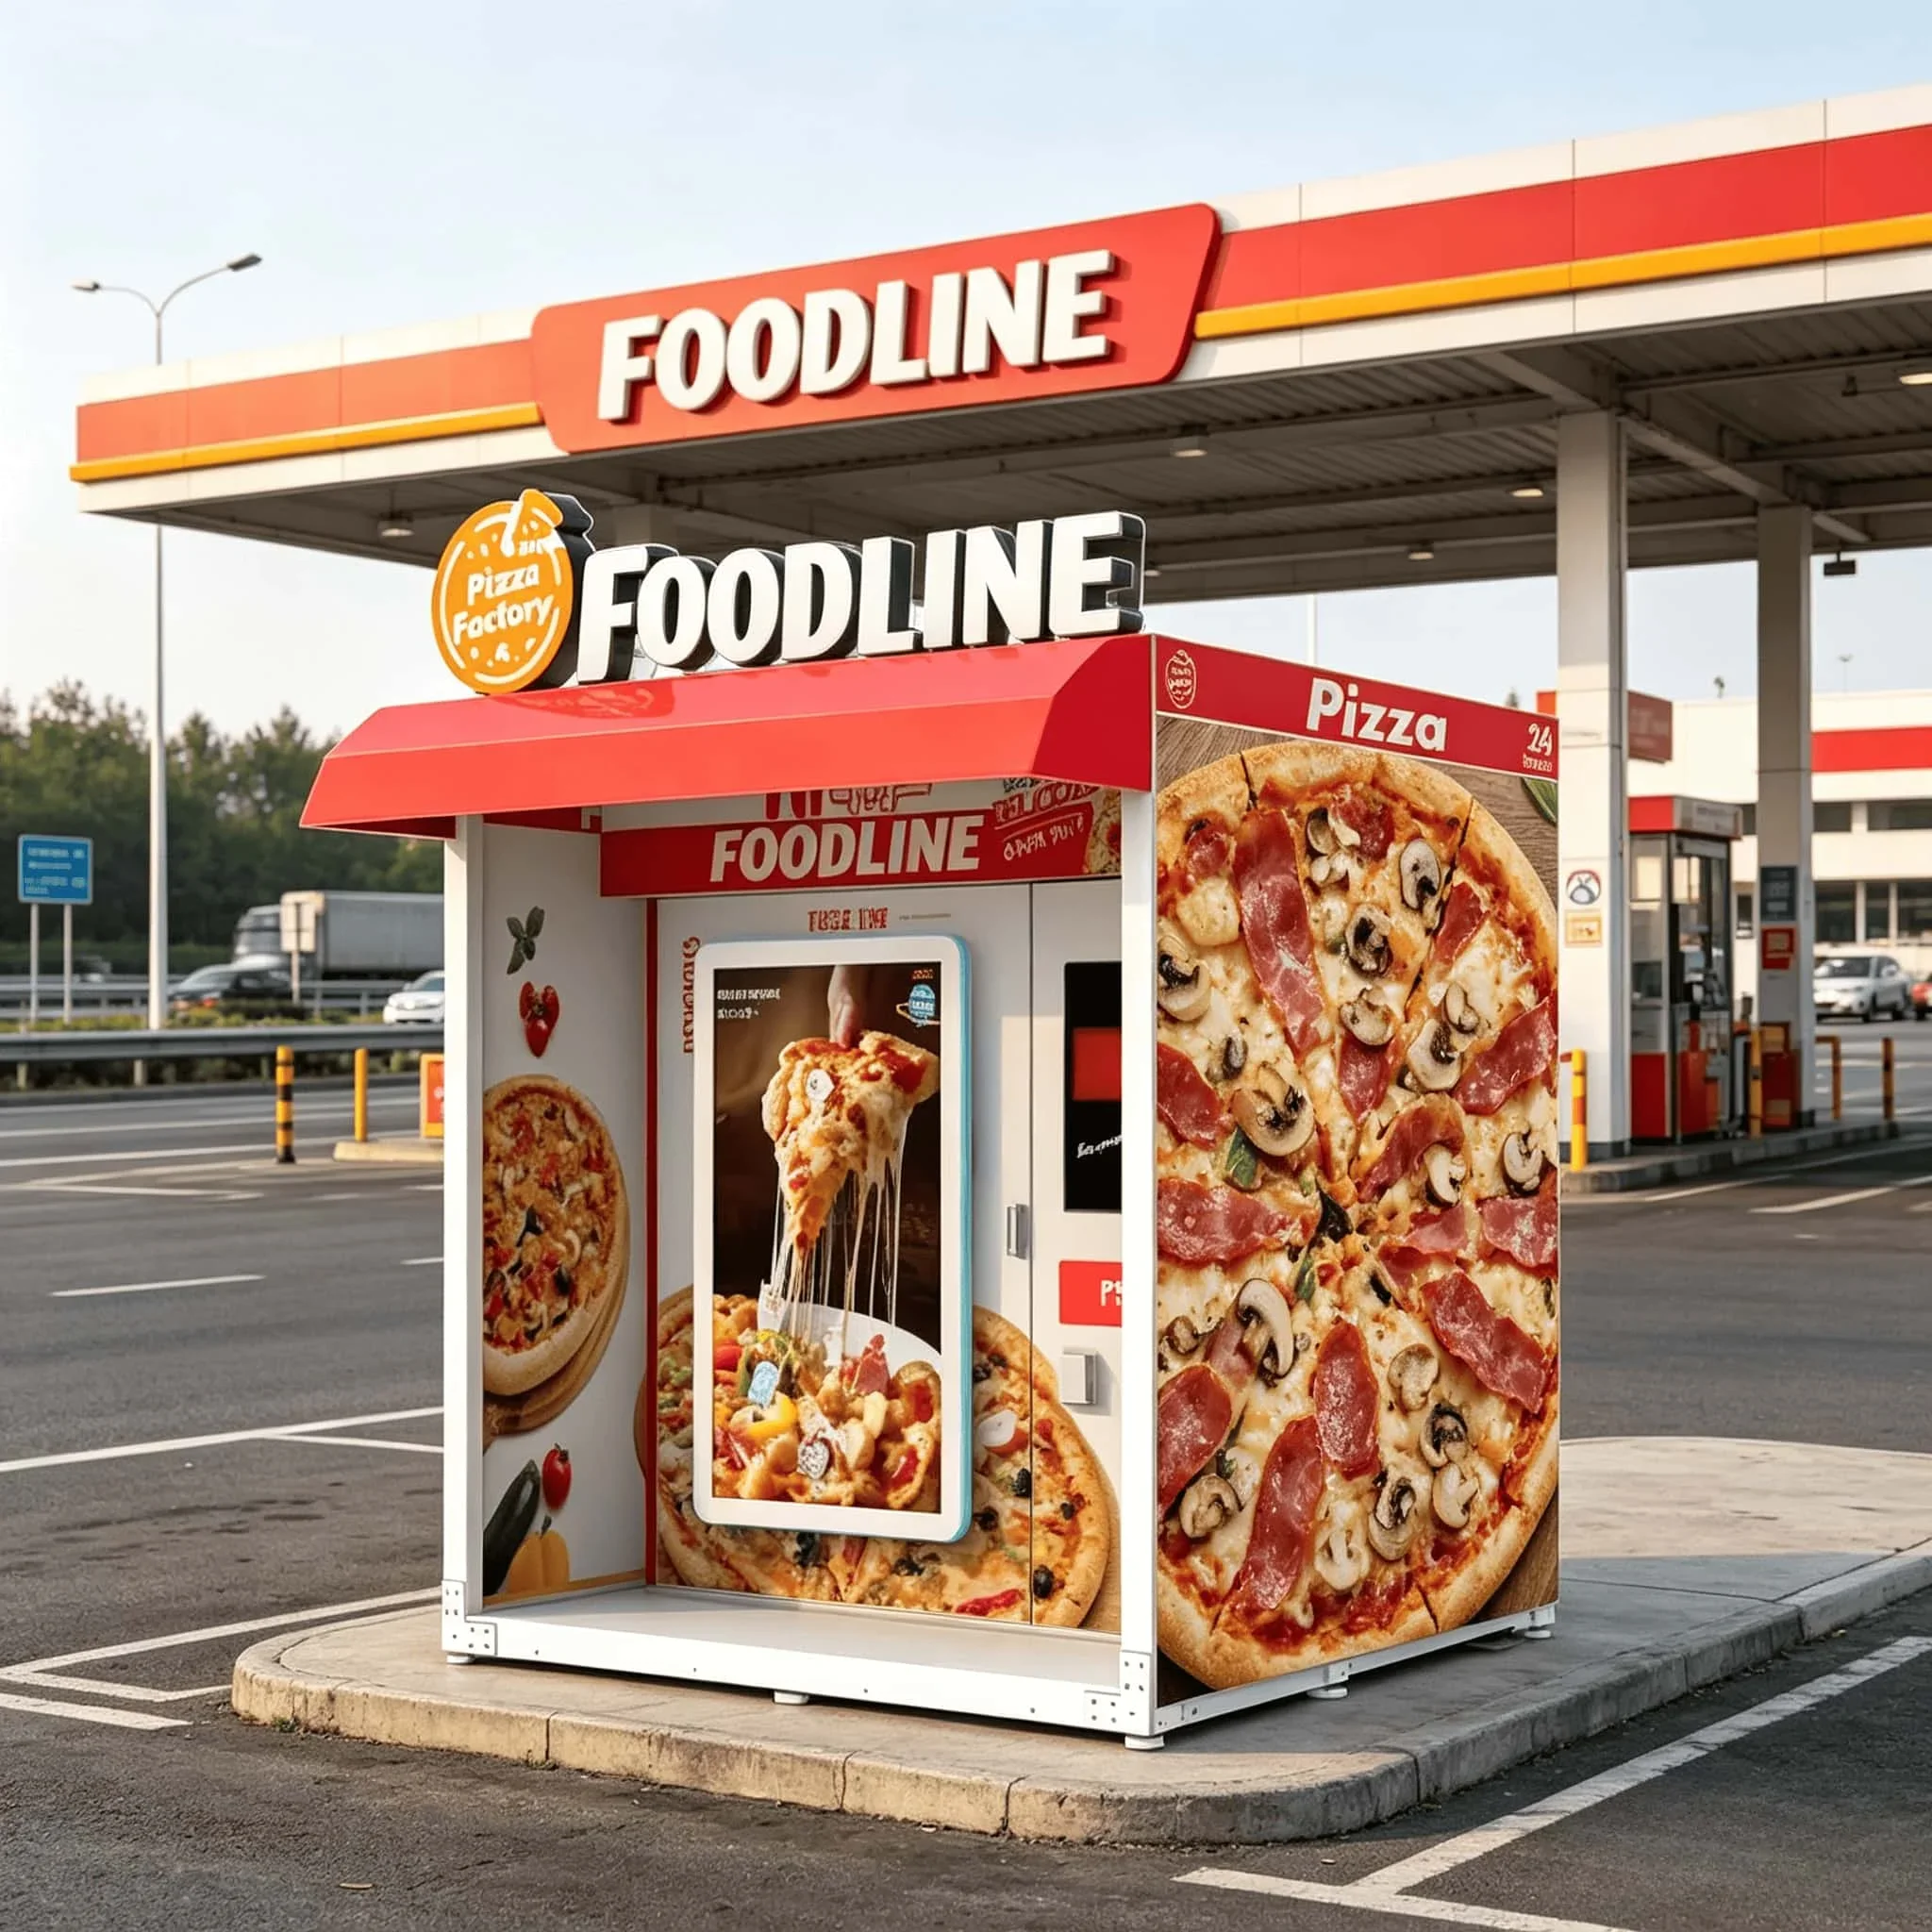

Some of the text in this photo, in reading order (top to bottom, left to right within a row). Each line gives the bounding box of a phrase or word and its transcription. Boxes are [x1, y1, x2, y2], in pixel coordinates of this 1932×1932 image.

[597, 248, 1117, 422] FOODLINE
[467, 563, 540, 607] Pizza
[575, 509, 1148, 684] FOODLINE
[452, 594, 555, 647] Factory
[1306, 676, 1448, 753] Pizza
[1526, 723, 1553, 757] 24
[708, 814, 985, 883] FOODLINE
